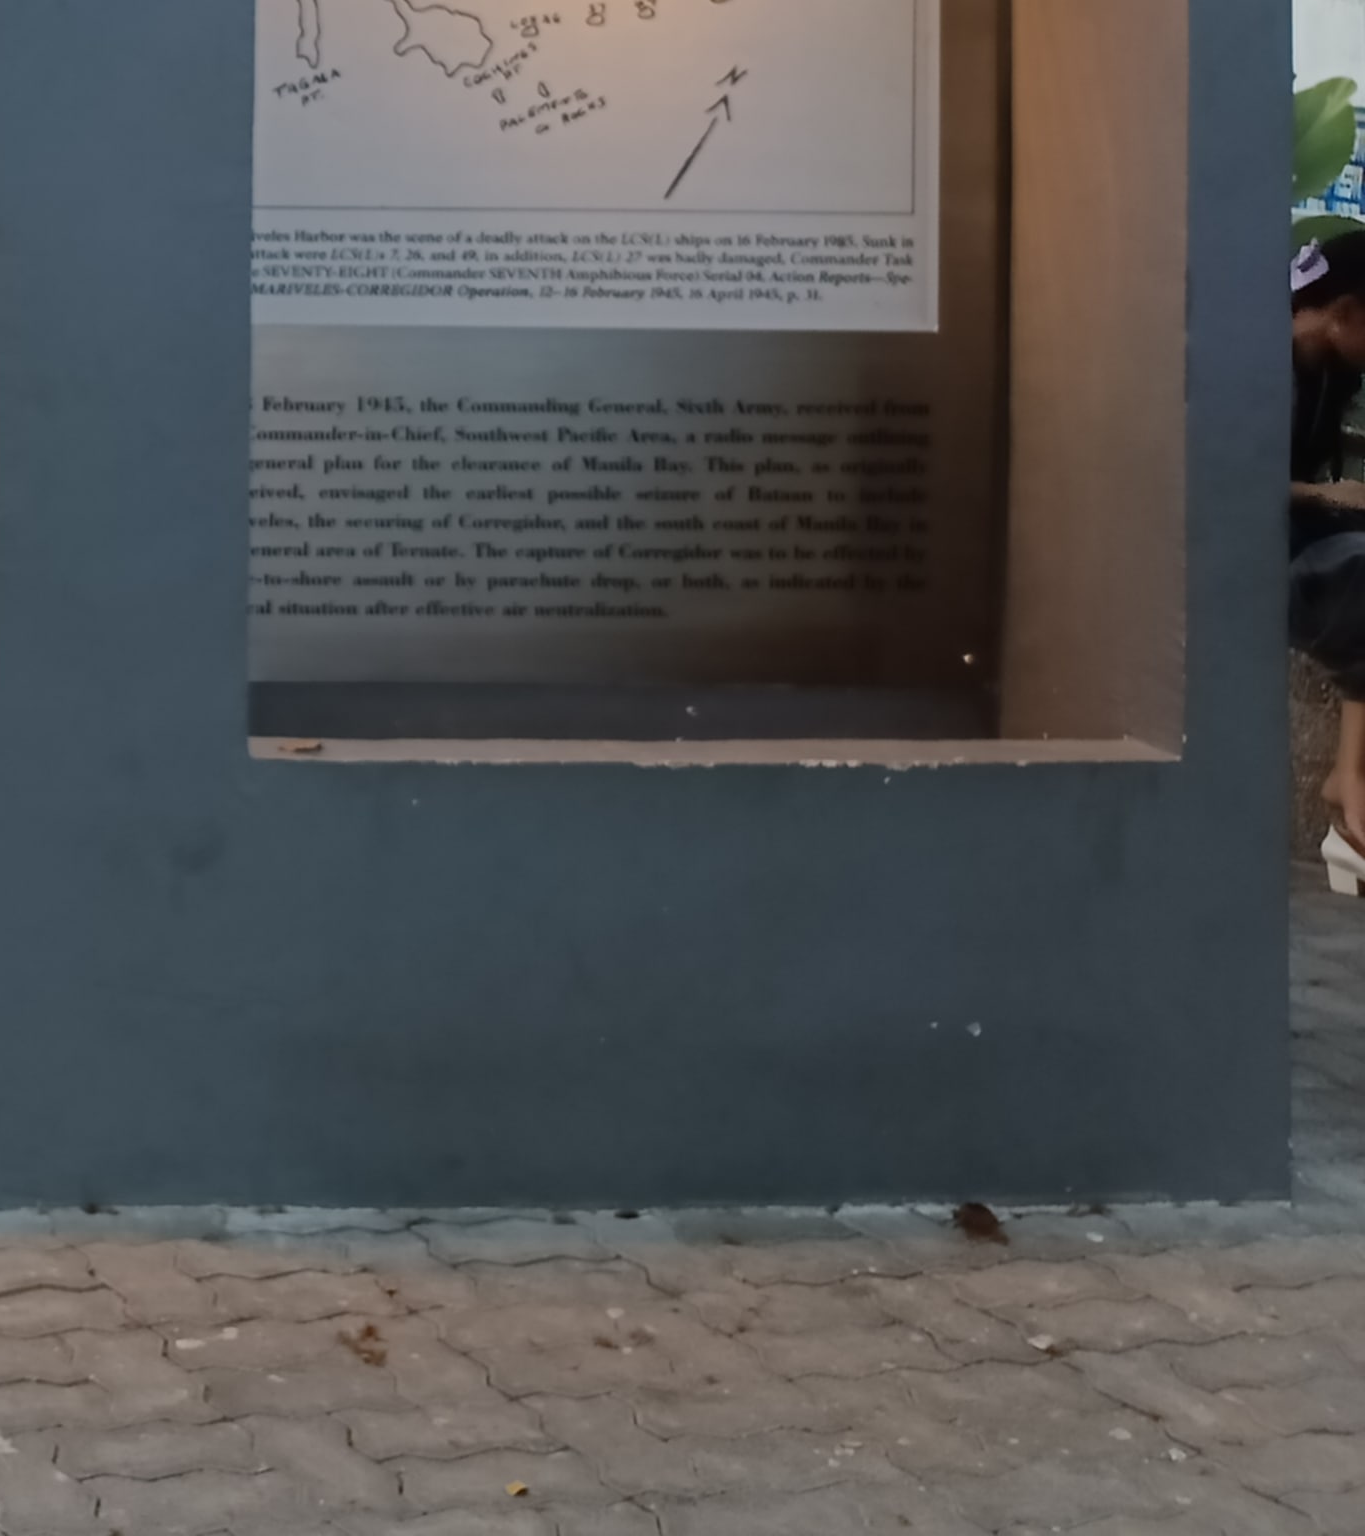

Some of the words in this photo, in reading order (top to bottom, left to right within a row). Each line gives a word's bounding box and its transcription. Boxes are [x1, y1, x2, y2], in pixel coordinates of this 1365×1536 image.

[263, 396, 345, 416] February
[420, 396, 449, 413] the
[676, 397, 725, 415] Sixth
[454, 426, 550, 443] Southwest
[557, 426, 618, 444] Pacific
[685, 432, 697, 444] a
[704, 427, 754, 444] radio
[324, 455, 363, 475] plan
[374, 455, 401, 471] for
[412, 455, 440, 471] the
[452, 456, 540, 472] clearance
[552, 456, 571, 472] of
[583, 456, 643, 473] Manila
[708, 455, 744, 473] This
[319, 484, 410, 503] envisaged
[423, 484, 451, 500] the
[466, 484, 534, 500] earliest
[547, 485, 621, 506] possible
[636, 487, 700, 502] seizure
[715, 485, 734, 501] of
[748, 486, 813, 504] Bataan
[308, 512, 336, 528] the
[345, 515, 424, 532] securing
[432, 513, 452, 529] of
[575, 515, 610, 531] and
[616, 515, 646, 531] the
[654, 514, 705, 531] south
[712, 517, 761, 531] coast
[768, 515, 789, 532] of
[316, 546, 356, 557] area
[363, 542, 382, 558] of
[476, 541, 507, 559] The
[516, 547, 585, 563] capture
[594, 544, 612, 559] of
[730, 548, 763, 560] was
[353, 571, 415, 588] assault
[425, 576, 444, 588] or
[455, 571, 476, 592] by
[487, 572, 580, 593] parachute
[652, 577, 671, 589] or
[278, 601, 360, 616] situation
[364, 599, 410, 616] after
[415, 600, 496, 617] effective
[502, 602, 528, 617] air
